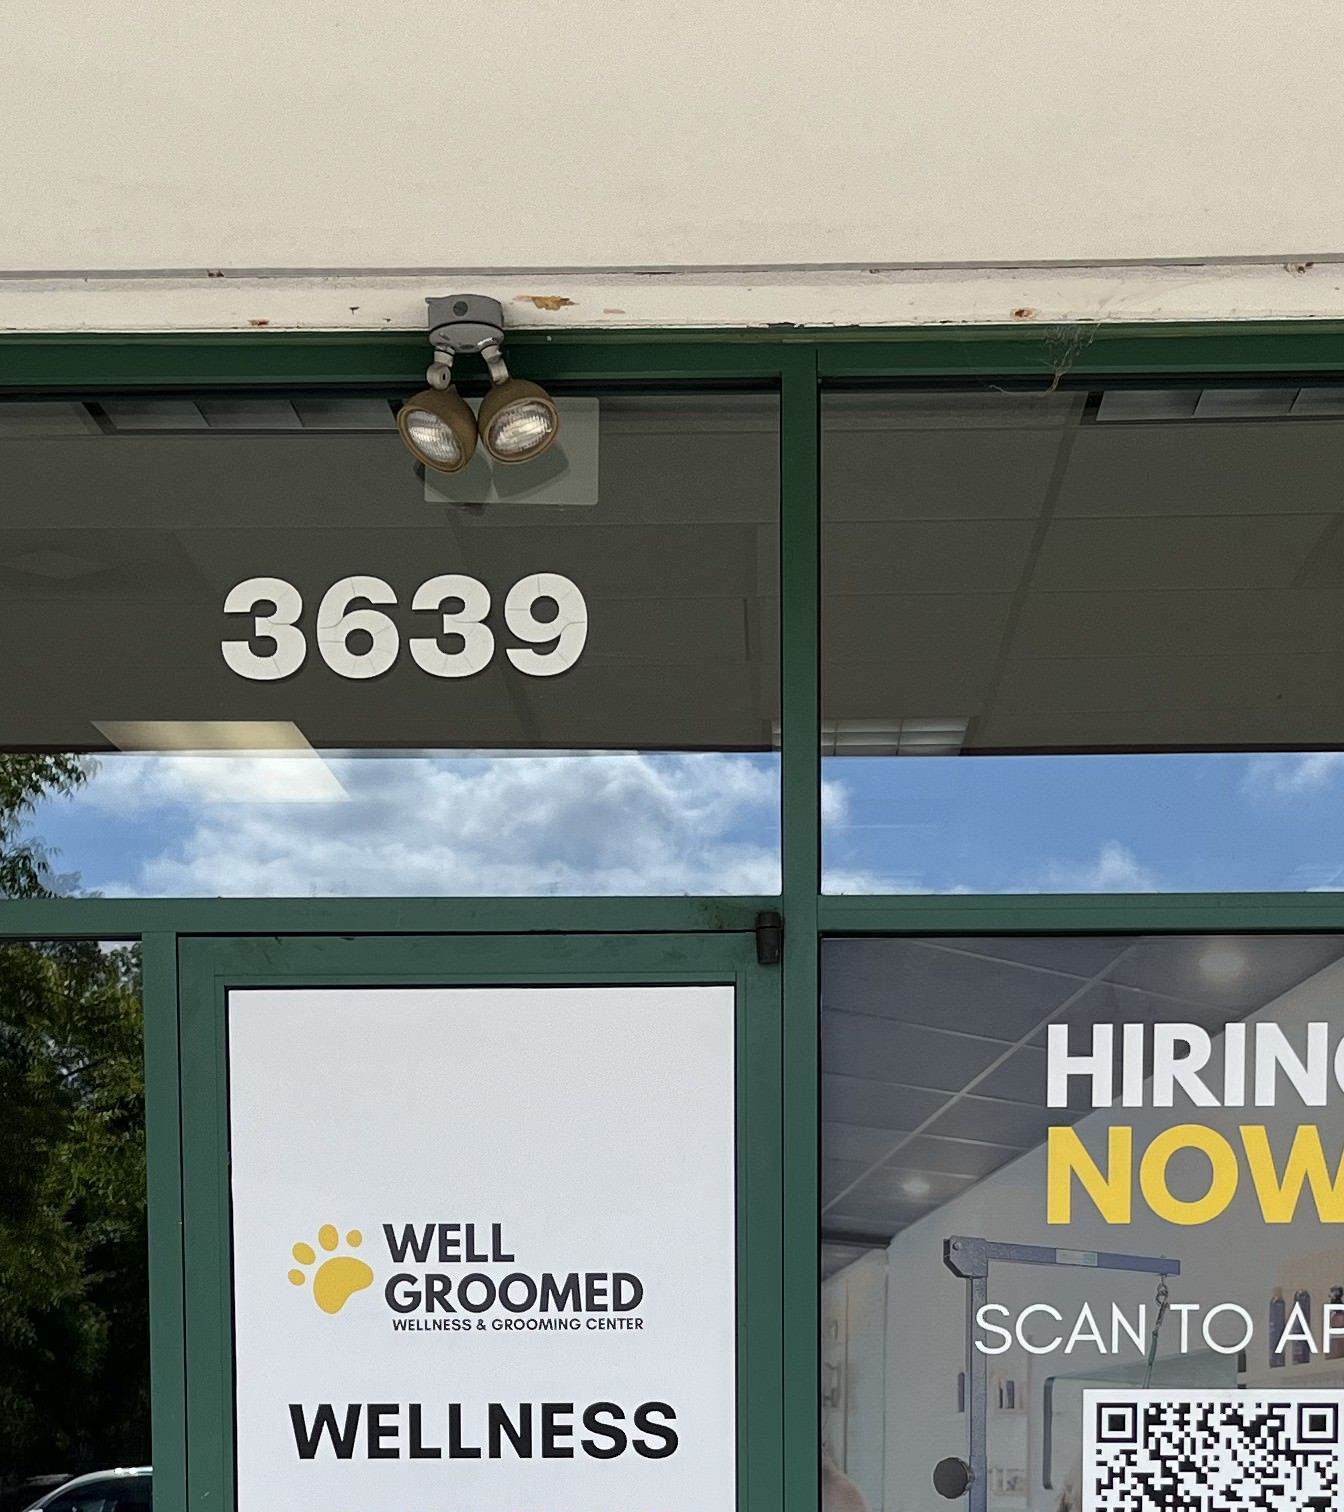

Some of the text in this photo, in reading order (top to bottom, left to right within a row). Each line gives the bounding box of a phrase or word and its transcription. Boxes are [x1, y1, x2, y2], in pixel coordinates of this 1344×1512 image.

[222, 573, 587, 680] 3639
[383, 1223, 514, 1263] WELL
[385, 1273, 643, 1313] GROOMED
[393, 1318, 643, 1330] WELLNESS & GROOMING CENTER
[975, 1303, 1146, 1356] SCAN
[1169, 1303, 1253, 1355] TO
[289, 1402, 678, 1459] WELLNESS
